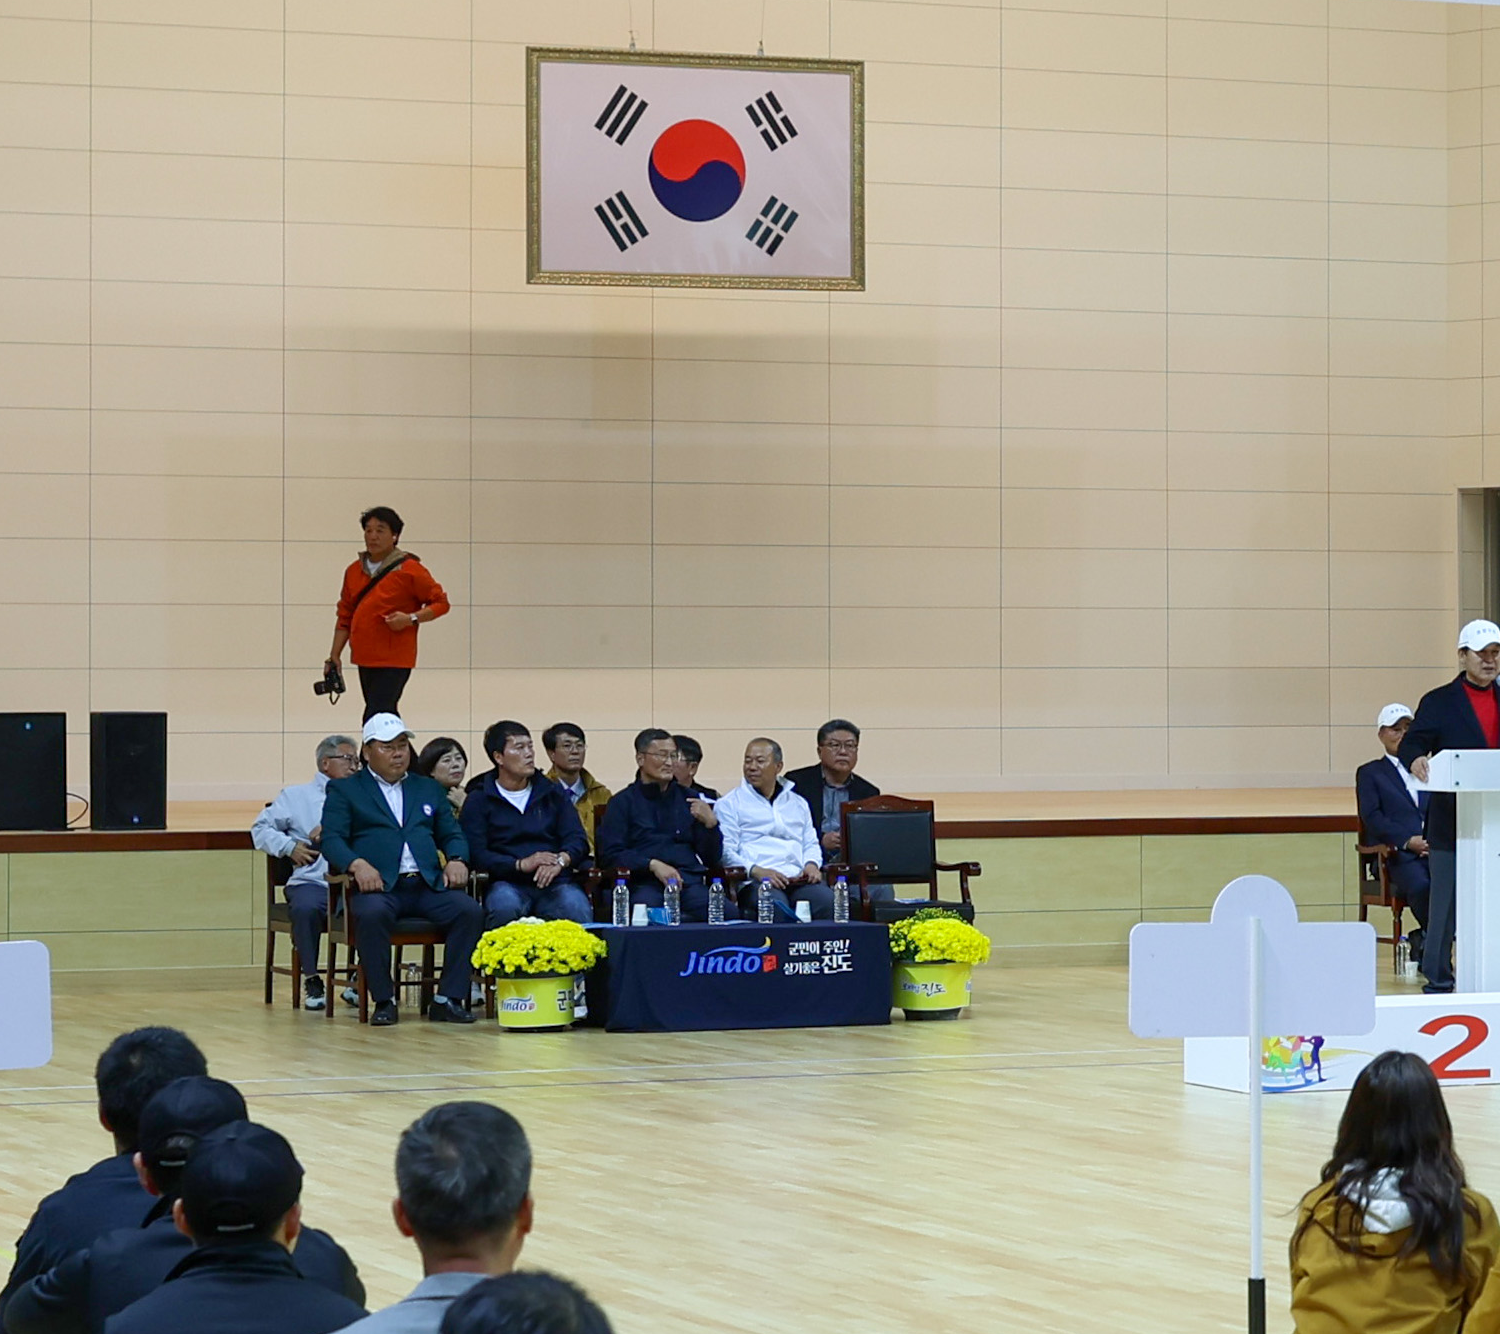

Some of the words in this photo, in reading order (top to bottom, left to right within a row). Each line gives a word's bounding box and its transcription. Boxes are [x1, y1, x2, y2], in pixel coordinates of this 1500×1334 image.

[788, 941, 820, 956] 군민이
[823, 939, 850, 954] 주인!
[679, 950, 762, 977] Jindo
[821, 953, 853, 974] 진도
[1418, 1014, 1491, 1079] 2
